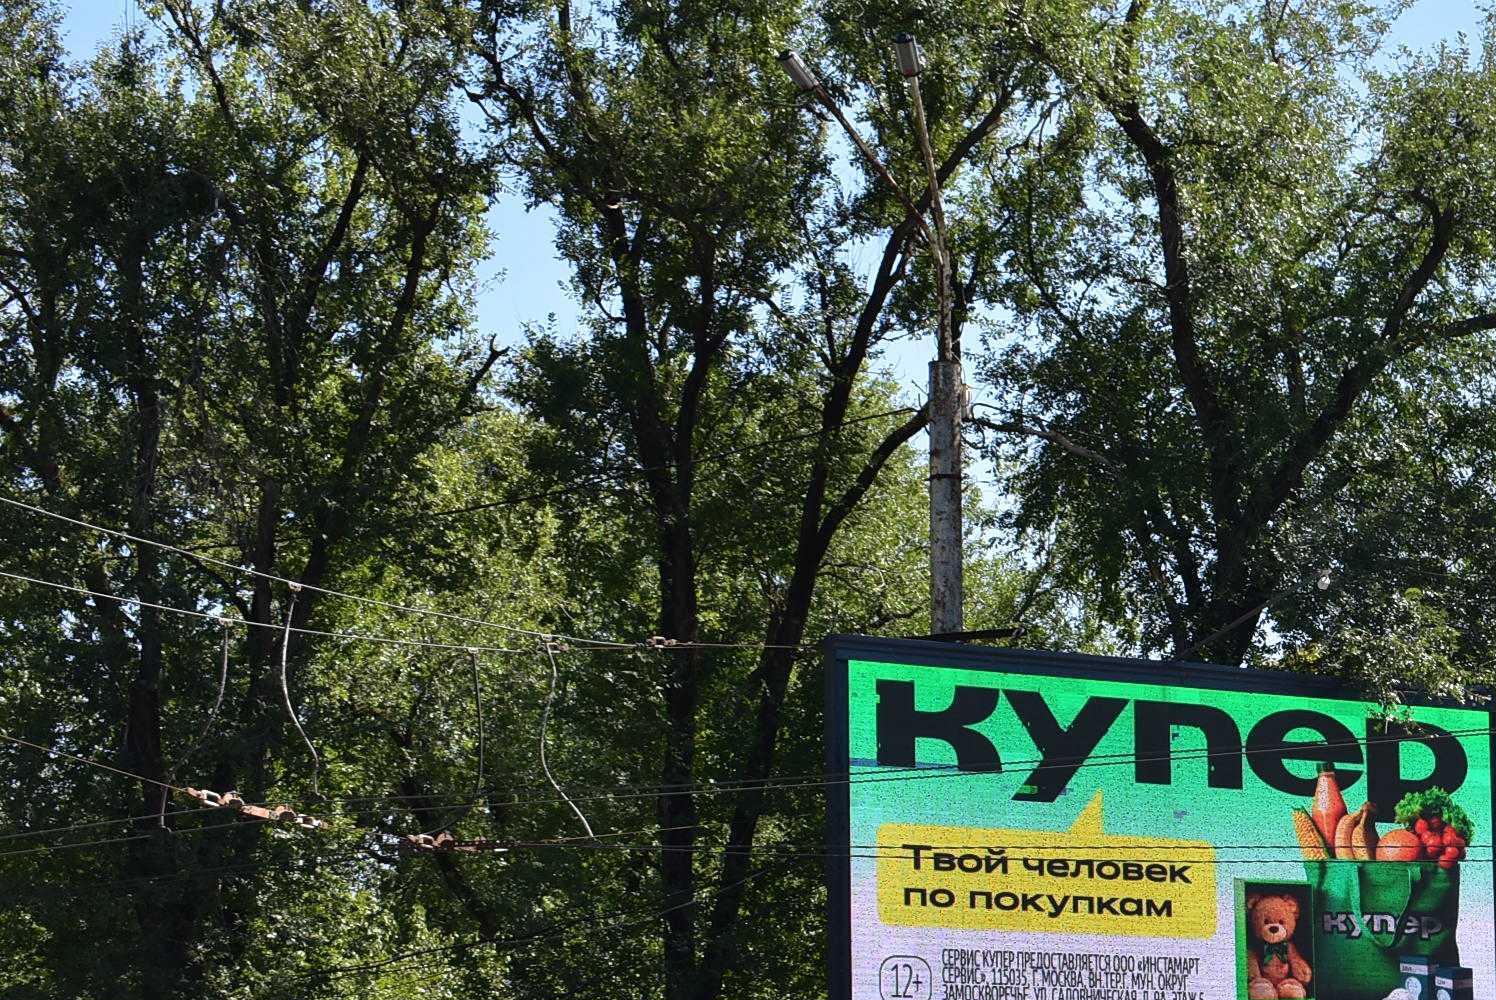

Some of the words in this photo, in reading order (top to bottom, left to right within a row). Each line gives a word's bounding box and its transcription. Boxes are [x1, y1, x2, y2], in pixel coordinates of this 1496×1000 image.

[902, 844, 1009, 875] Твой
[1022, 857, 1192, 884] человек
[903, 887, 955, 908] по
[968, 890, 1174, 919] покупкам
[941, 948, 981, 967] СЕРВИС
[982, 950, 1015, 969] КУПЕР
[1017, 951, 1111, 972] ПРЕДОСТАВЛЯЕТСЯ
[1113, 954, 1135, 972] ООО
[1137, 956, 1201, 975] «ИНСТАМАРТ
[890, 963, 923, 999] 12+
[991, 968, 1030, 988] 115035,
[1032, 970, 1040, 987] Г.
[1041, 970, 1086, 989] МОСКВА,
[1131, 973, 1156, 990] МУН.
[1158, 974, 1189, 991] ОКРУГ
